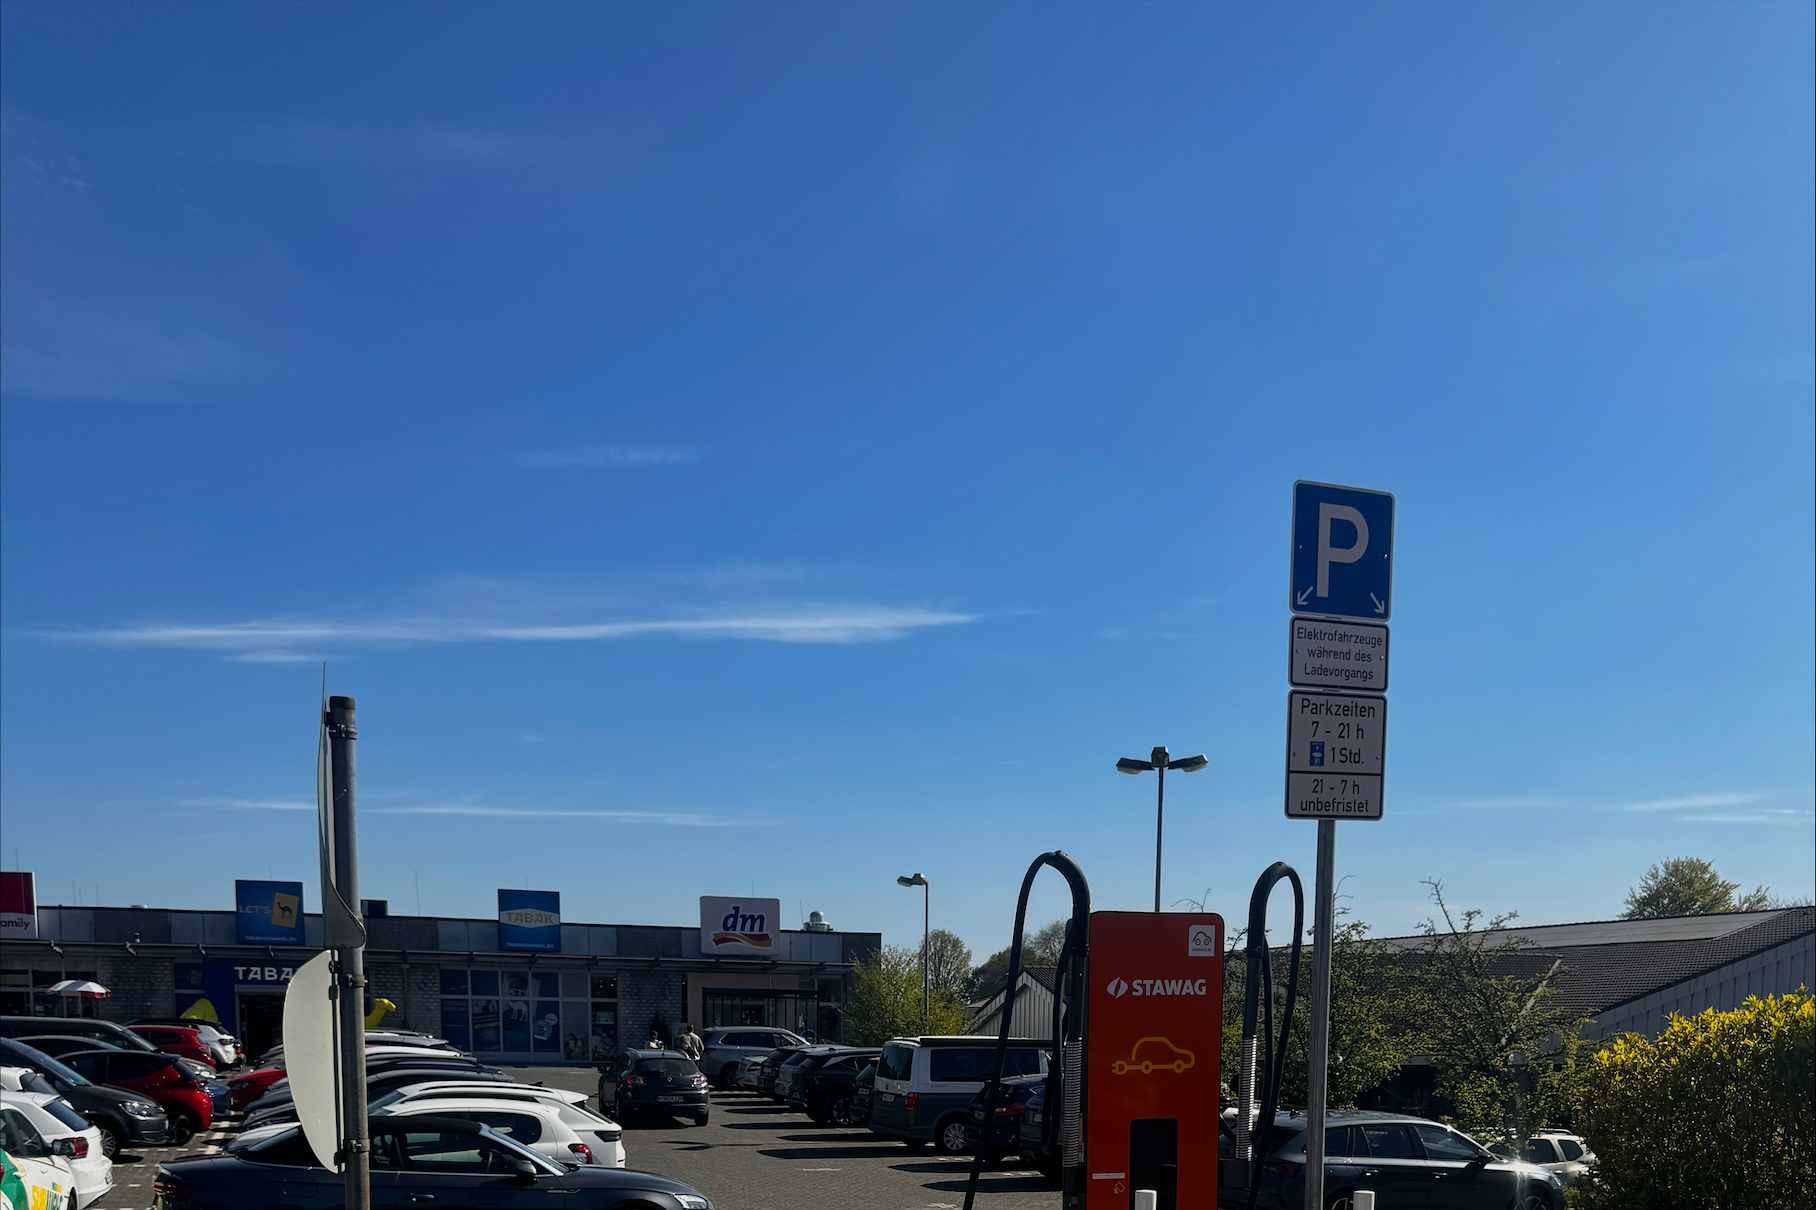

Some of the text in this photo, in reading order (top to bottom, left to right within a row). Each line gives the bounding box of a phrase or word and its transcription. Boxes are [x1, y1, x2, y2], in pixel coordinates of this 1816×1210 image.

[1316, 502, 1370, 598] P
[1297, 627, 1383, 648] Elektrofahrzeuge
[1307, 646, 1372, 662] während des
[1304, 663, 1374, 682] Ladevorgangs
[1301, 698, 1375, 718] Parkzeiten
[1311, 721, 1319, 738] 7
[1338, 722, 1350, 739] 21
[1356, 723, 1364, 739] h
[1312, 779, 1323, 794] 21
[1340, 780, 1347, 795] 7
[1352, 780, 1360, 795] h
[1300, 797, 1369, 813] unbefristet
[239, 905, 272, 914] LET'S
[505, 912, 555, 924] TABAK
[722, 906, 765, 932] dm
[234, 966, 300, 981] TABA
[1132, 979, 1207, 996] STAWAG
